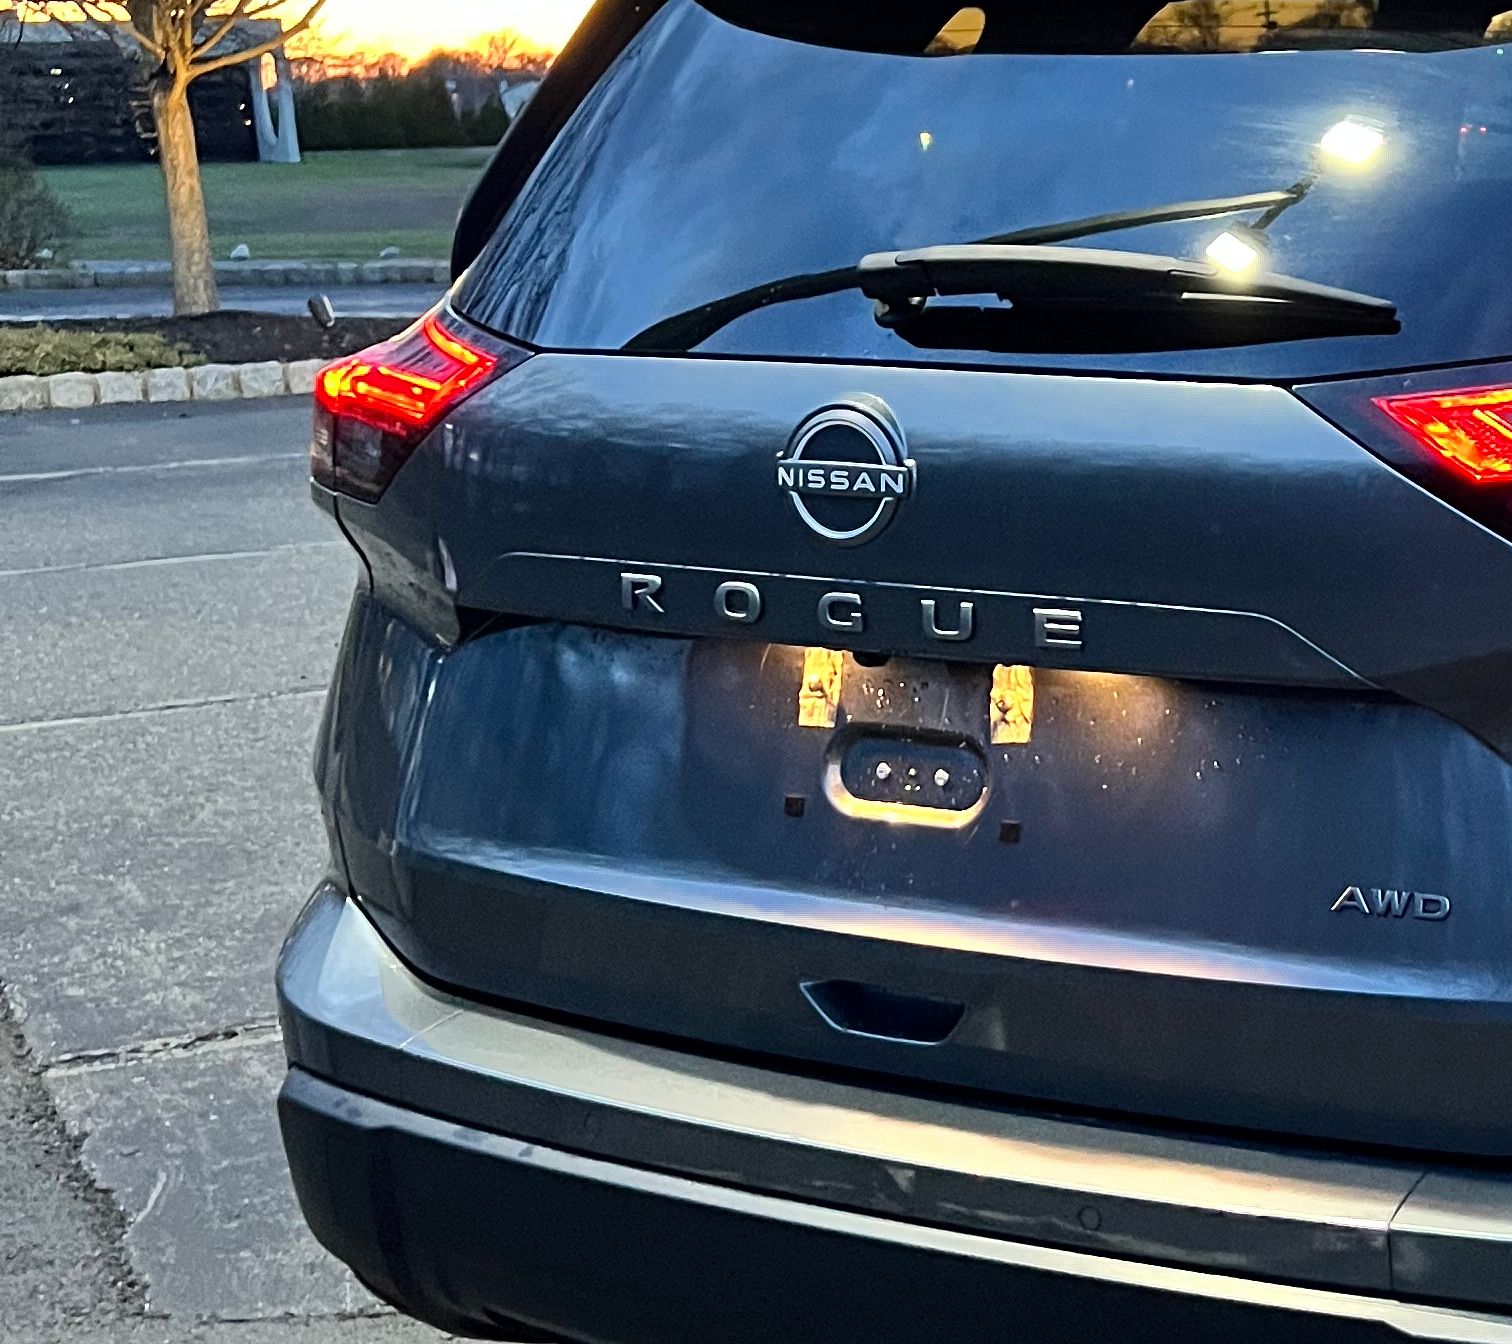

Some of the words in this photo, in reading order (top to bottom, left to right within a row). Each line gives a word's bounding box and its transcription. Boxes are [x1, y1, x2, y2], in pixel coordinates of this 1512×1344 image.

[777, 466, 904, 494] NISSAN
[620, 572, 1083, 649] ROGUE
[1330, 885, 1451, 921] AWD
